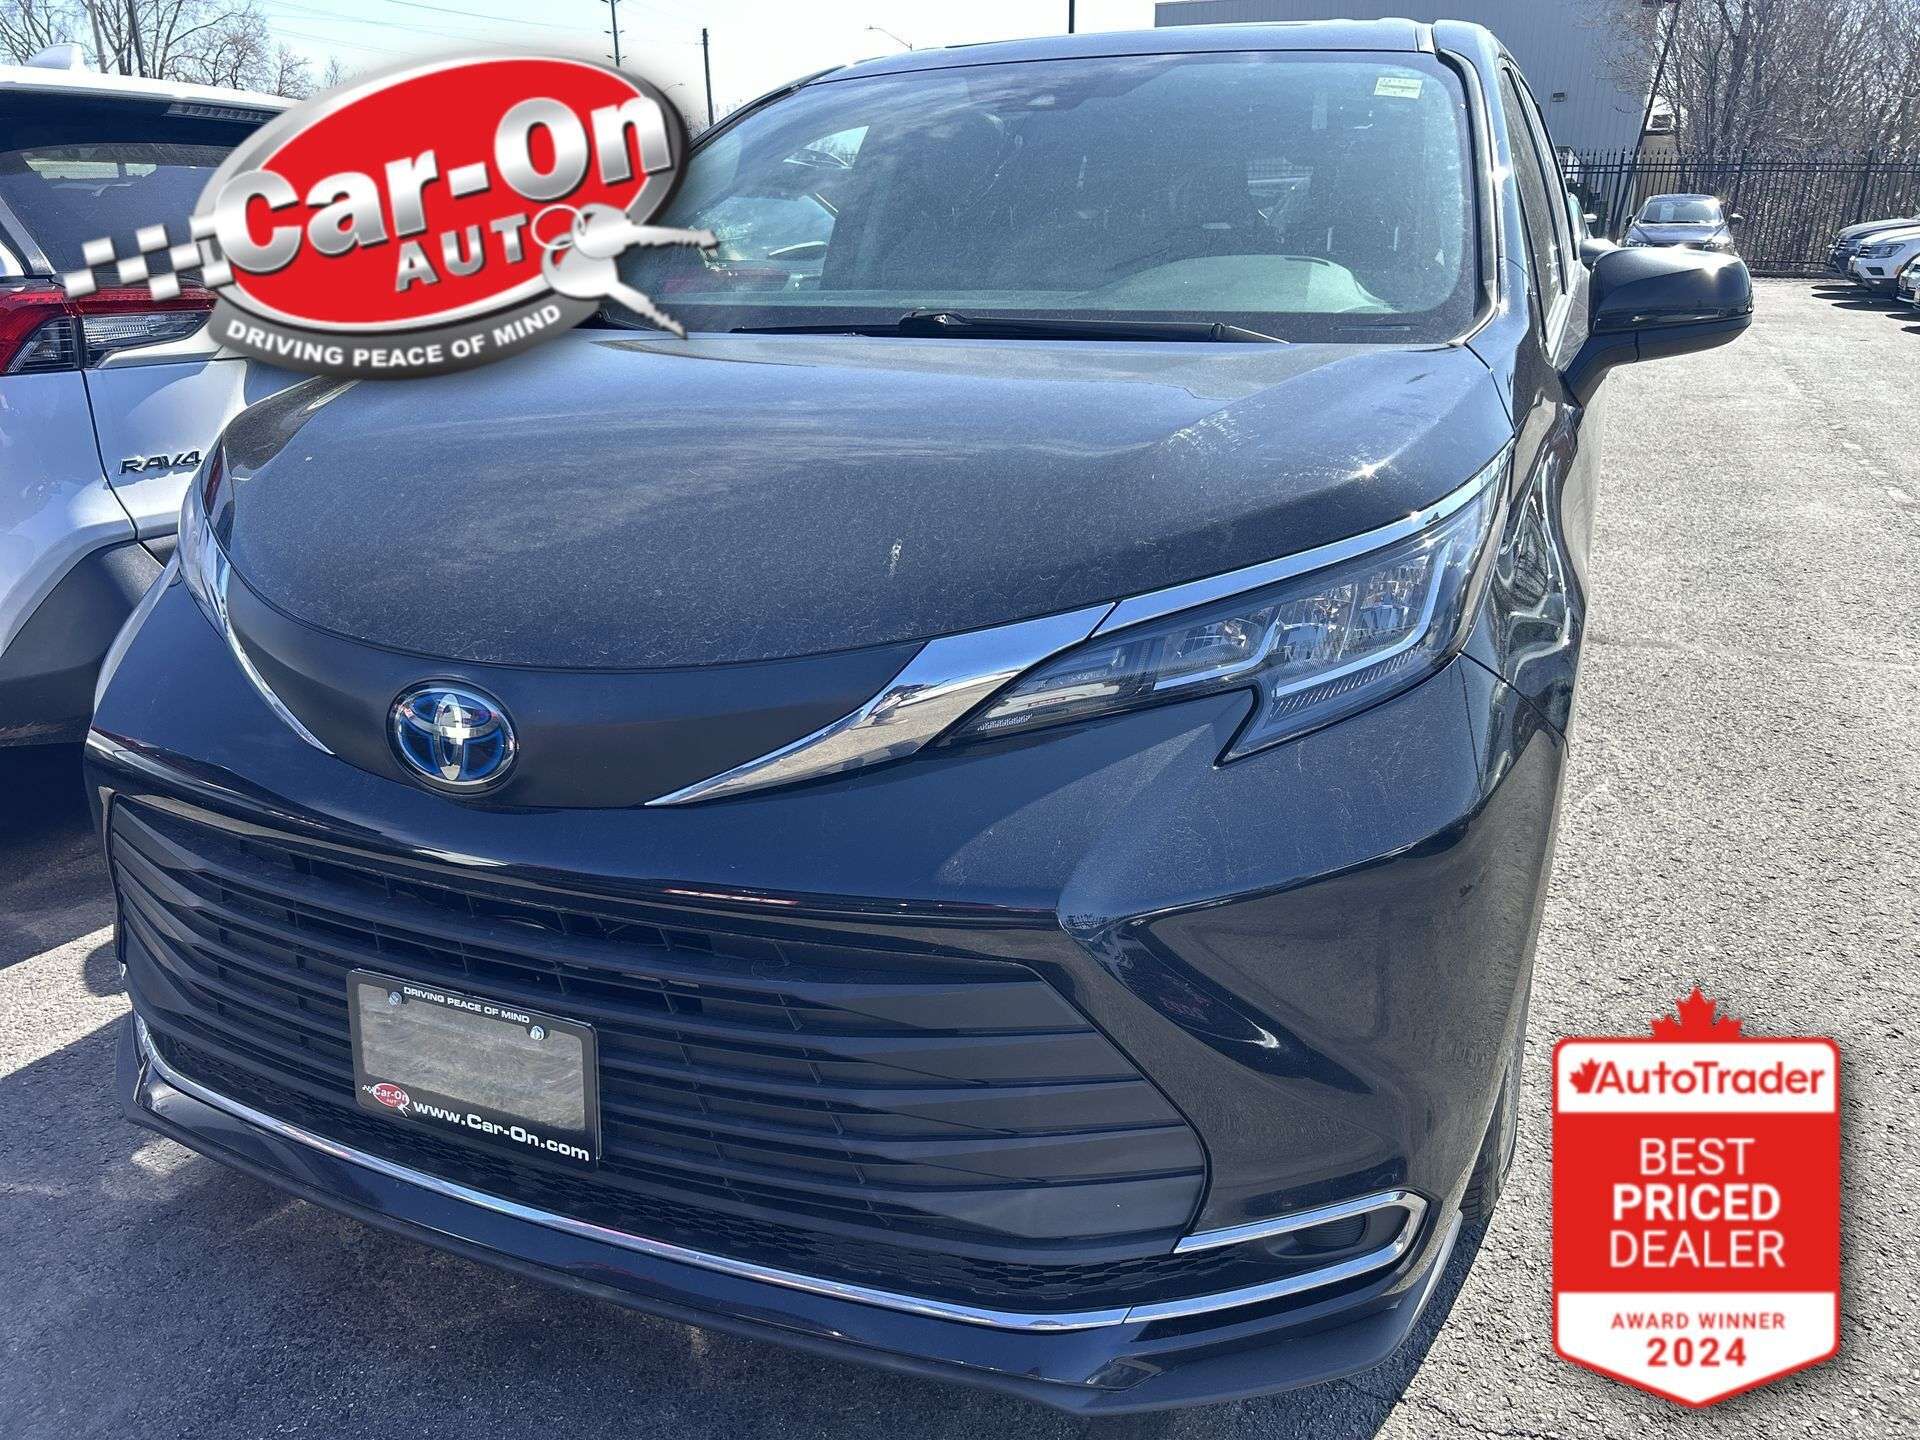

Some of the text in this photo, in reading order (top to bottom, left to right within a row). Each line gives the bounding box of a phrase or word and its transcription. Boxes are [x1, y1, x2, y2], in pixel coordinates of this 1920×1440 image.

[118, 451, 202, 475] RAV4
[403, 986, 530, 1024] DRIVING PEACE OF MIND
[373, 1087, 408, 1102] Car-On
[412, 1101, 590, 1161] www.Car-On.com
